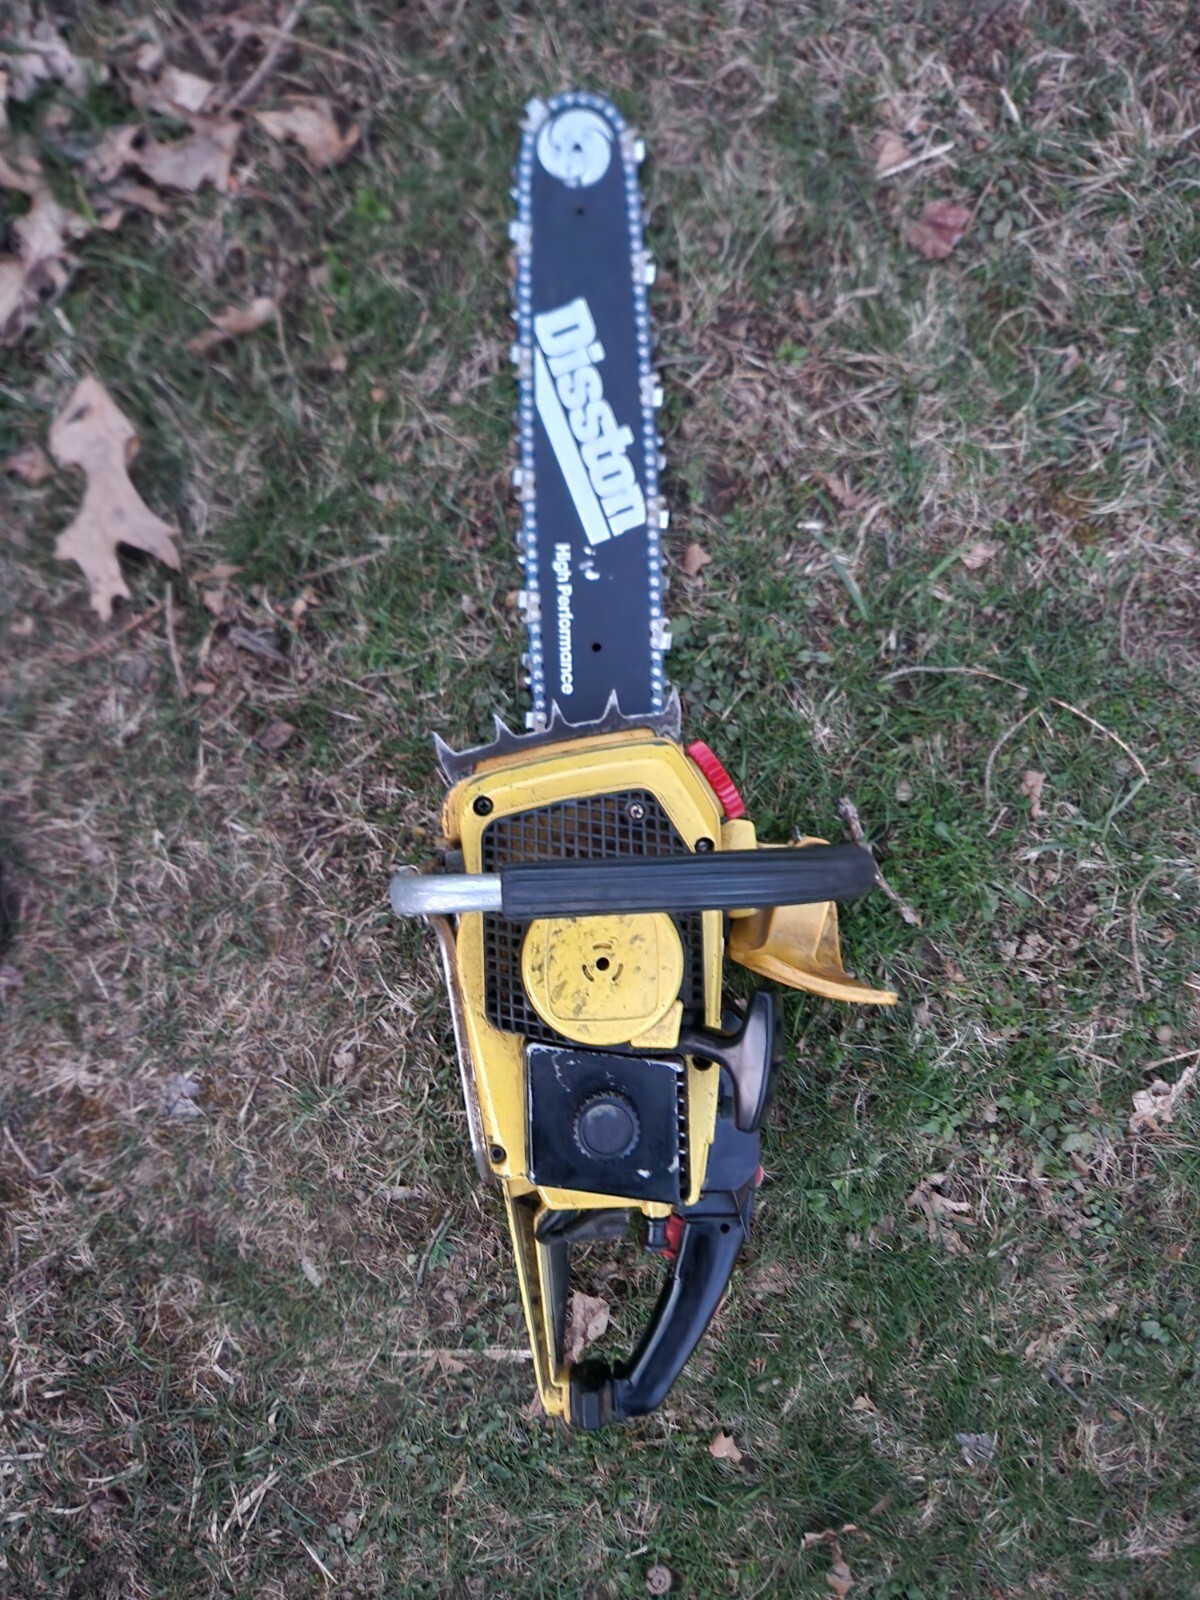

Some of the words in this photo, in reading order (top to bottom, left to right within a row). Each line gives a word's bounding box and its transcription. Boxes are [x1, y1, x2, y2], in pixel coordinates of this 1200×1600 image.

[534, 297, 646, 537] Disston
[552, 542, 571, 583] High
[556, 584, 574, 695] Performance
